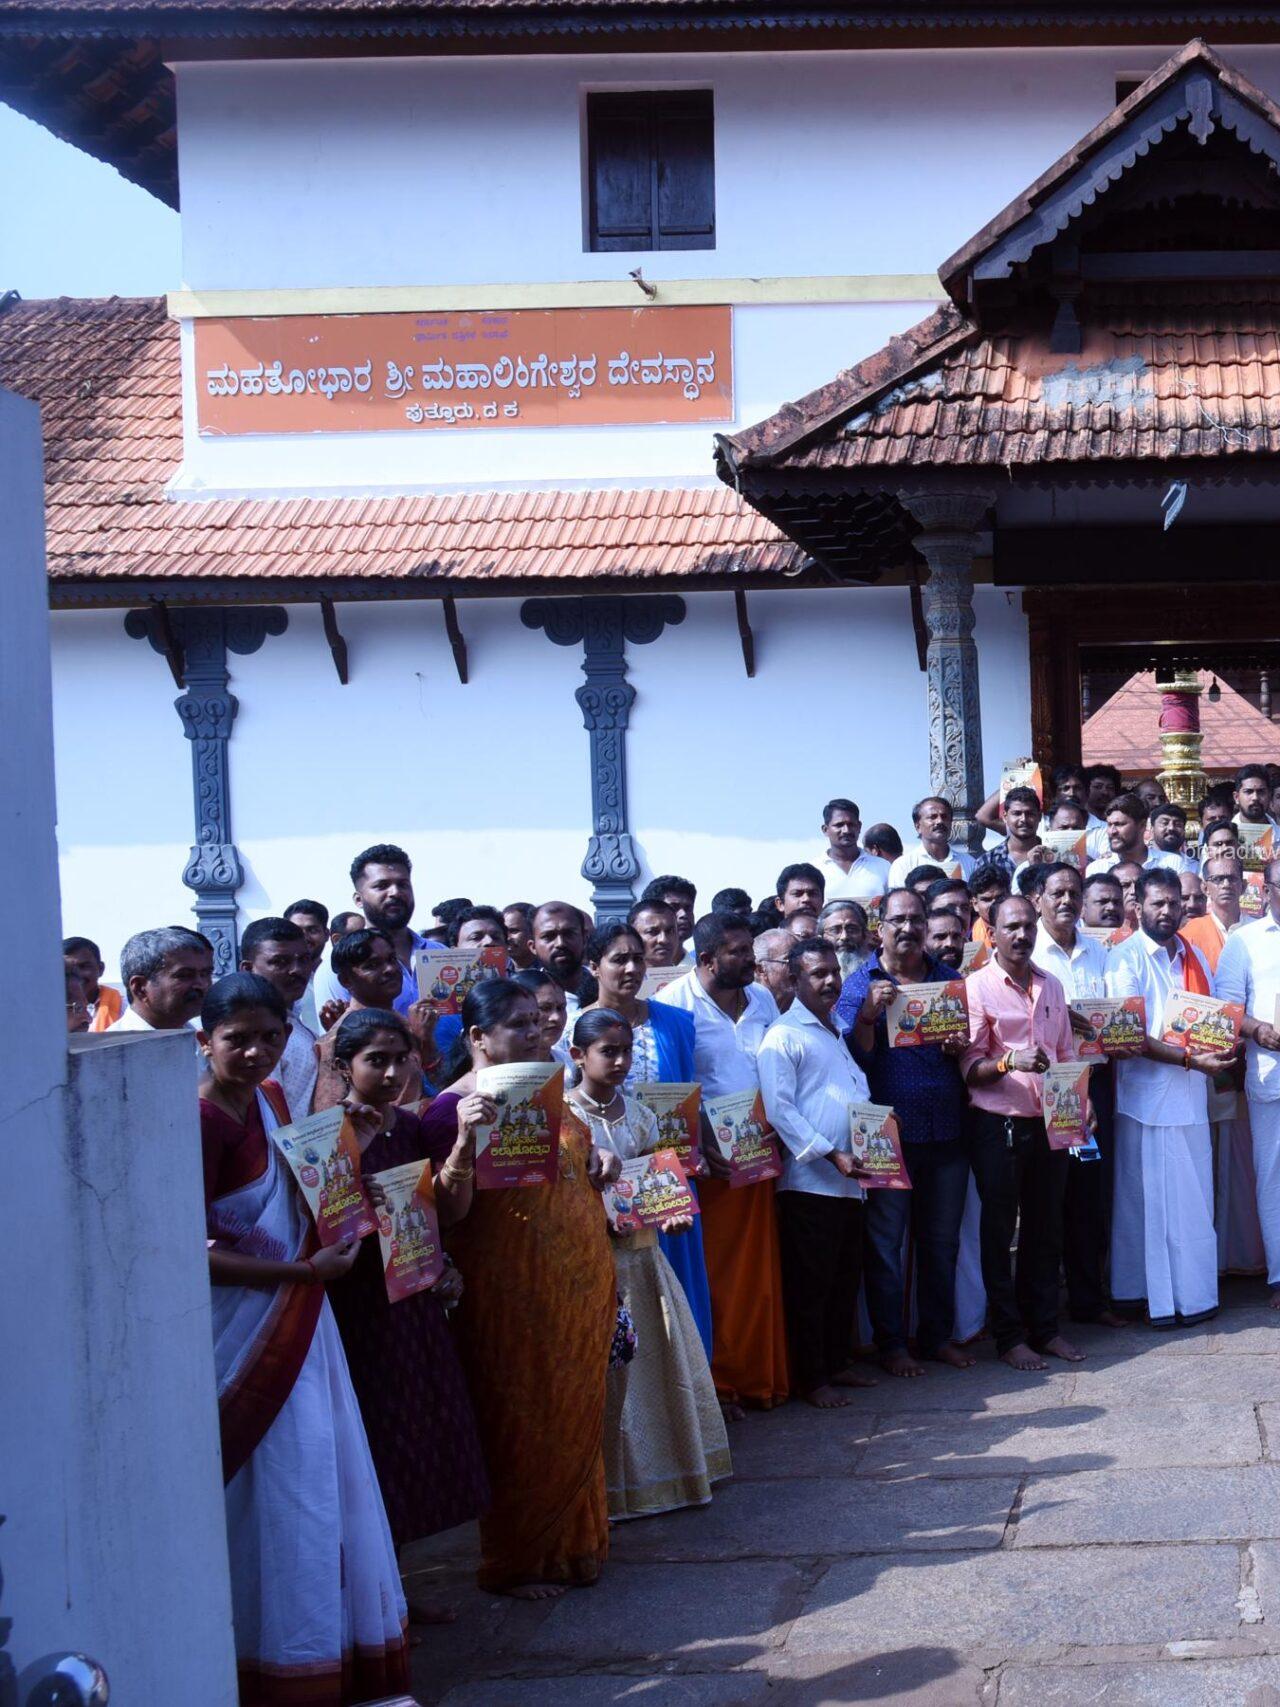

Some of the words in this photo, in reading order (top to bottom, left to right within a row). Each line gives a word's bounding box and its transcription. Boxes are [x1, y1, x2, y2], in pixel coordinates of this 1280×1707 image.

[206, 356, 372, 400] ಮಹತೋಭಾರ
[384, 359, 415, 399] ಶ್ರೀ
[421, 353, 597, 399] ಮಹಾಲಿಂಗೇಶ್ವರ
[607, 350, 716, 401] ದೇವಸ್ಥಾನ
